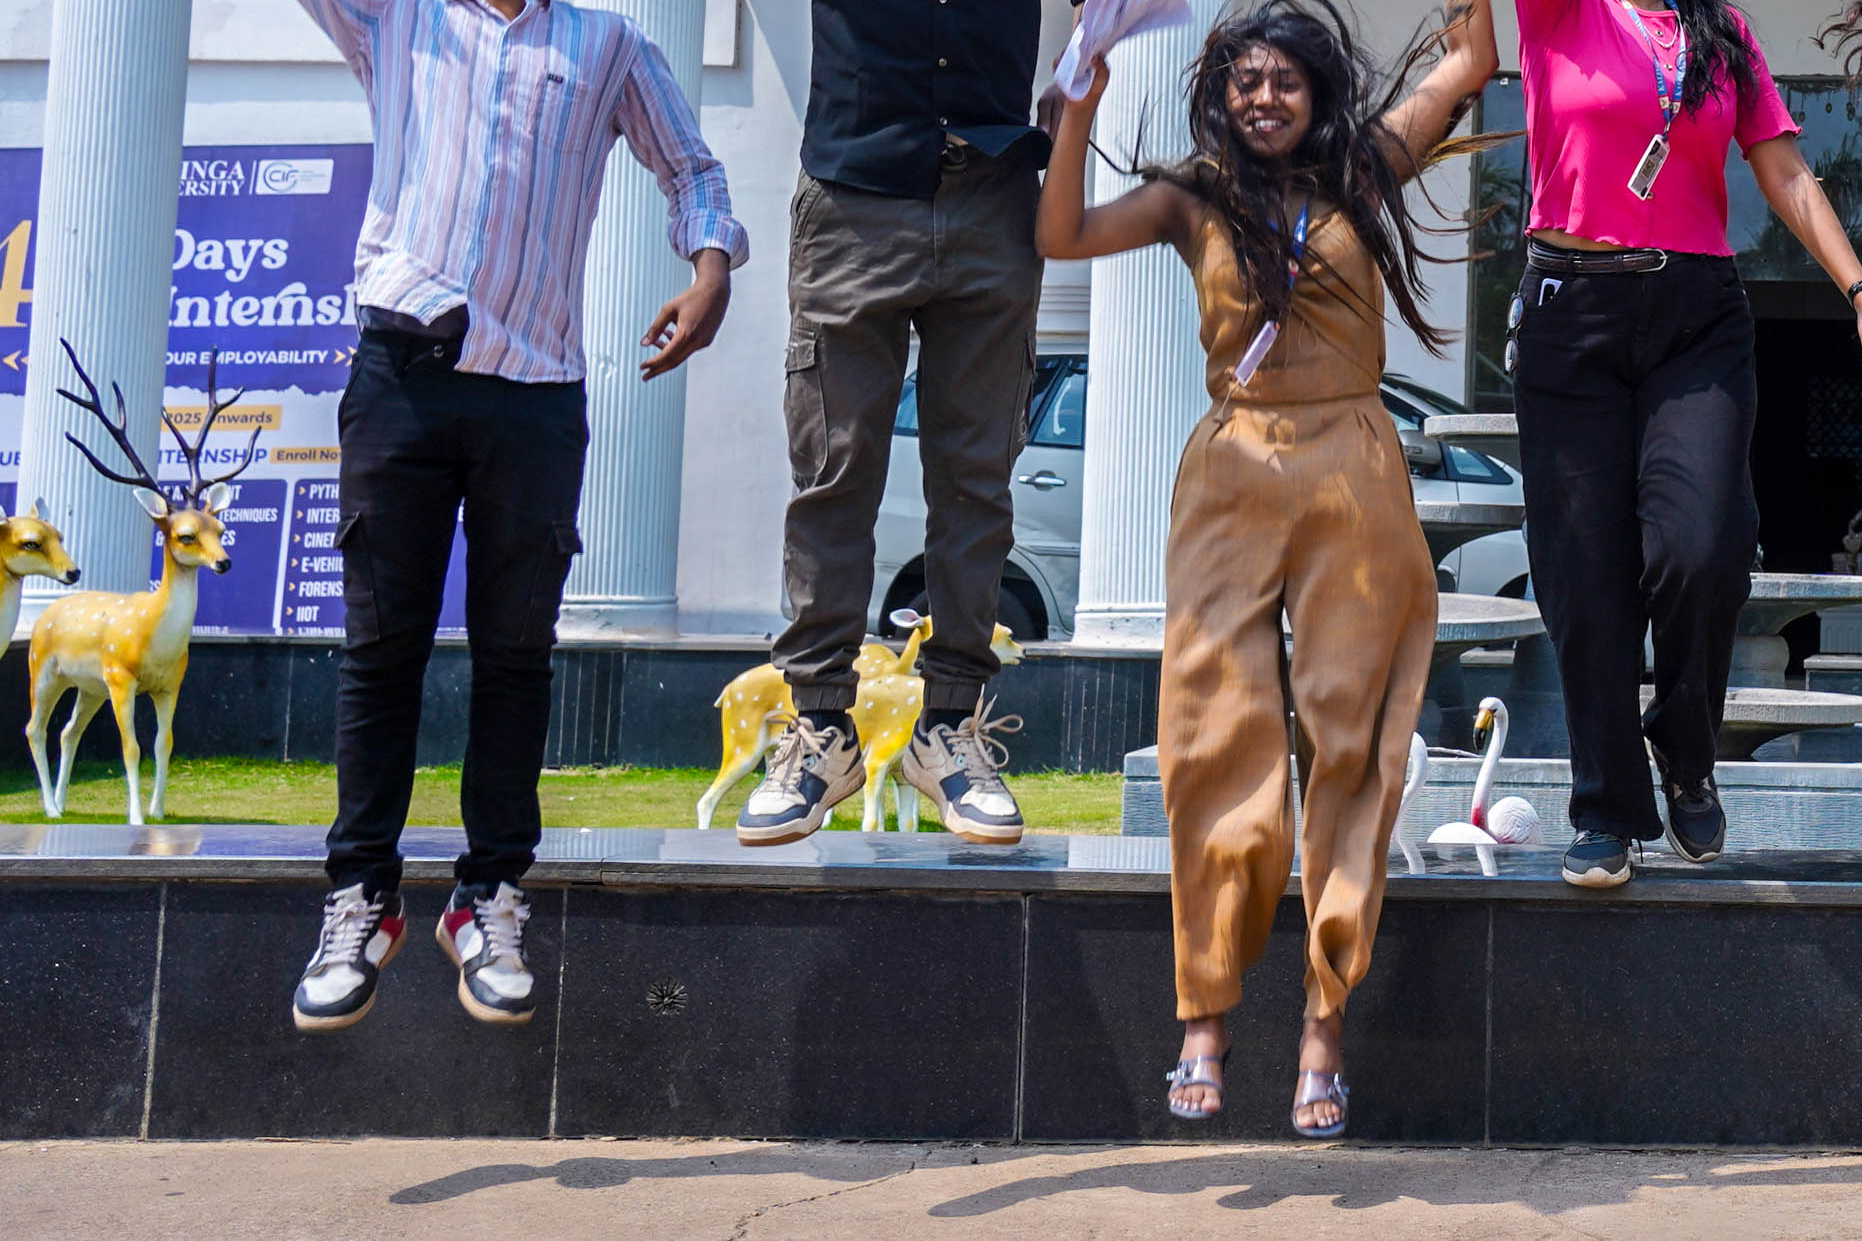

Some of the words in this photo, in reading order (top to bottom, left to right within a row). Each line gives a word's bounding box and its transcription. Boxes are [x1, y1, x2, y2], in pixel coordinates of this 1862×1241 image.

[180, 160, 245, 180] INGA
[178, 180, 245, 197] ERSITY
[172, 228, 289, 283] Days
[165, 350, 198, 366] OUR
[217, 411, 273, 424] nwards
[276, 449, 317, 462] Enroll
[319, 448, 342, 461] No
[309, 483, 340, 500] PYTH
[306, 507, 341, 525] INTER
[299, 580, 345, 598] FORENS
